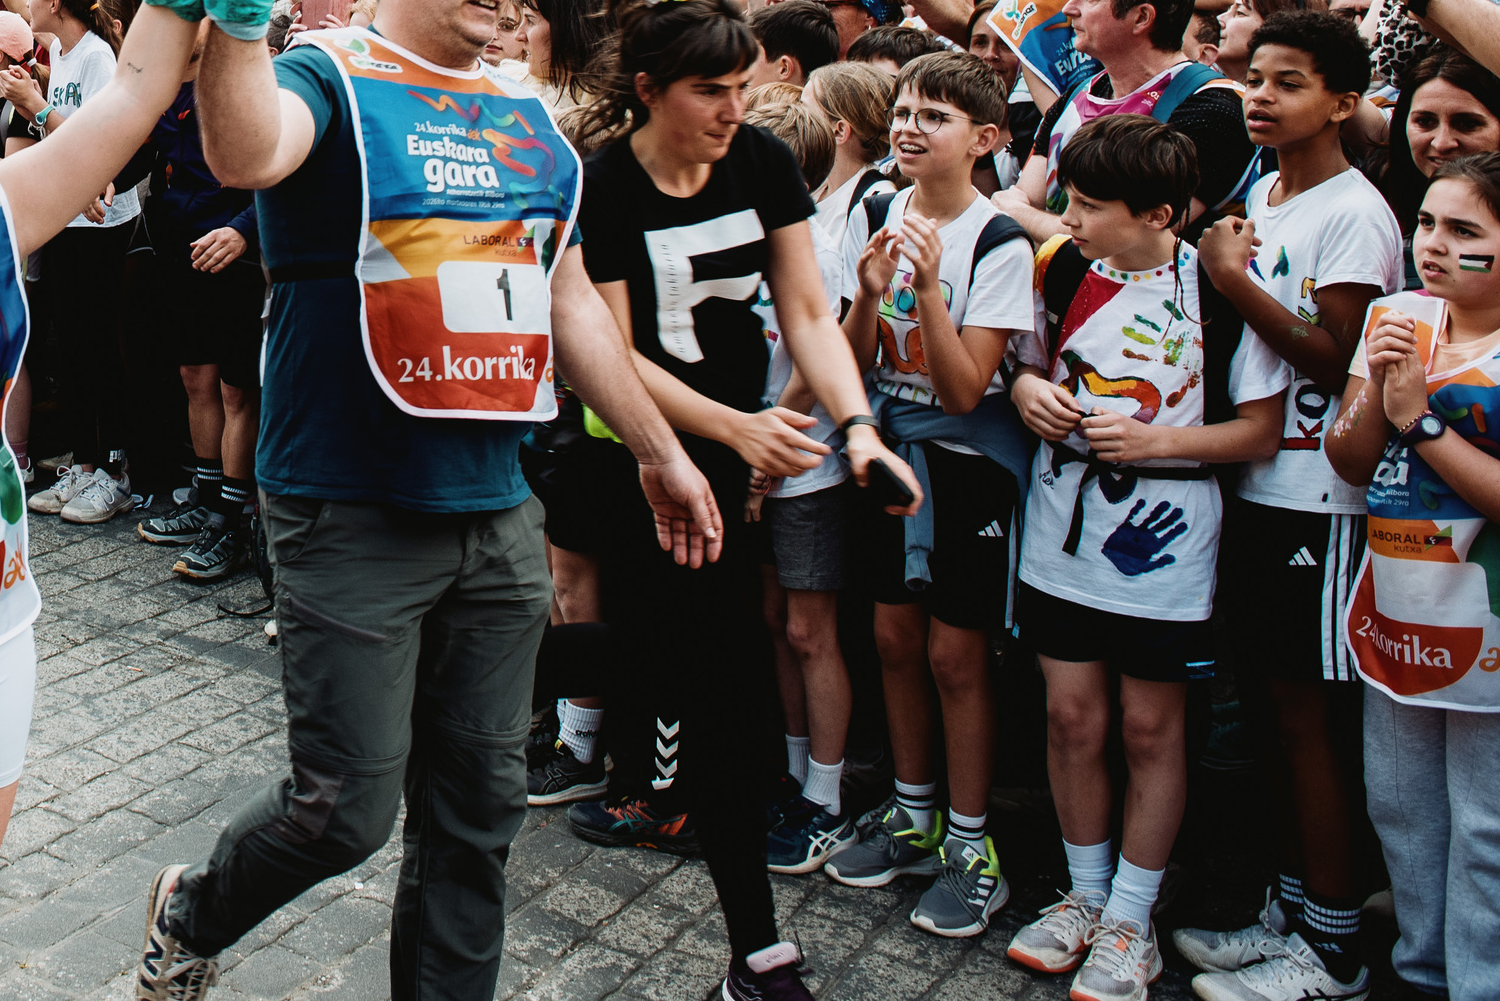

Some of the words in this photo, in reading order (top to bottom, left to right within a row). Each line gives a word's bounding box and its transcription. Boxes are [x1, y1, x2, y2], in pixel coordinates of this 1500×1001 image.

[414, 120, 467, 138] 24.korrika
[406, 134, 490, 164] Euskara
[423, 158, 500, 193] gara
[463, 234, 516, 248] LABORAL
[496, 268, 514, 322] 1
[397, 345, 535, 383] 24.korrika
[1393, 544, 1423, 554] kutxa
